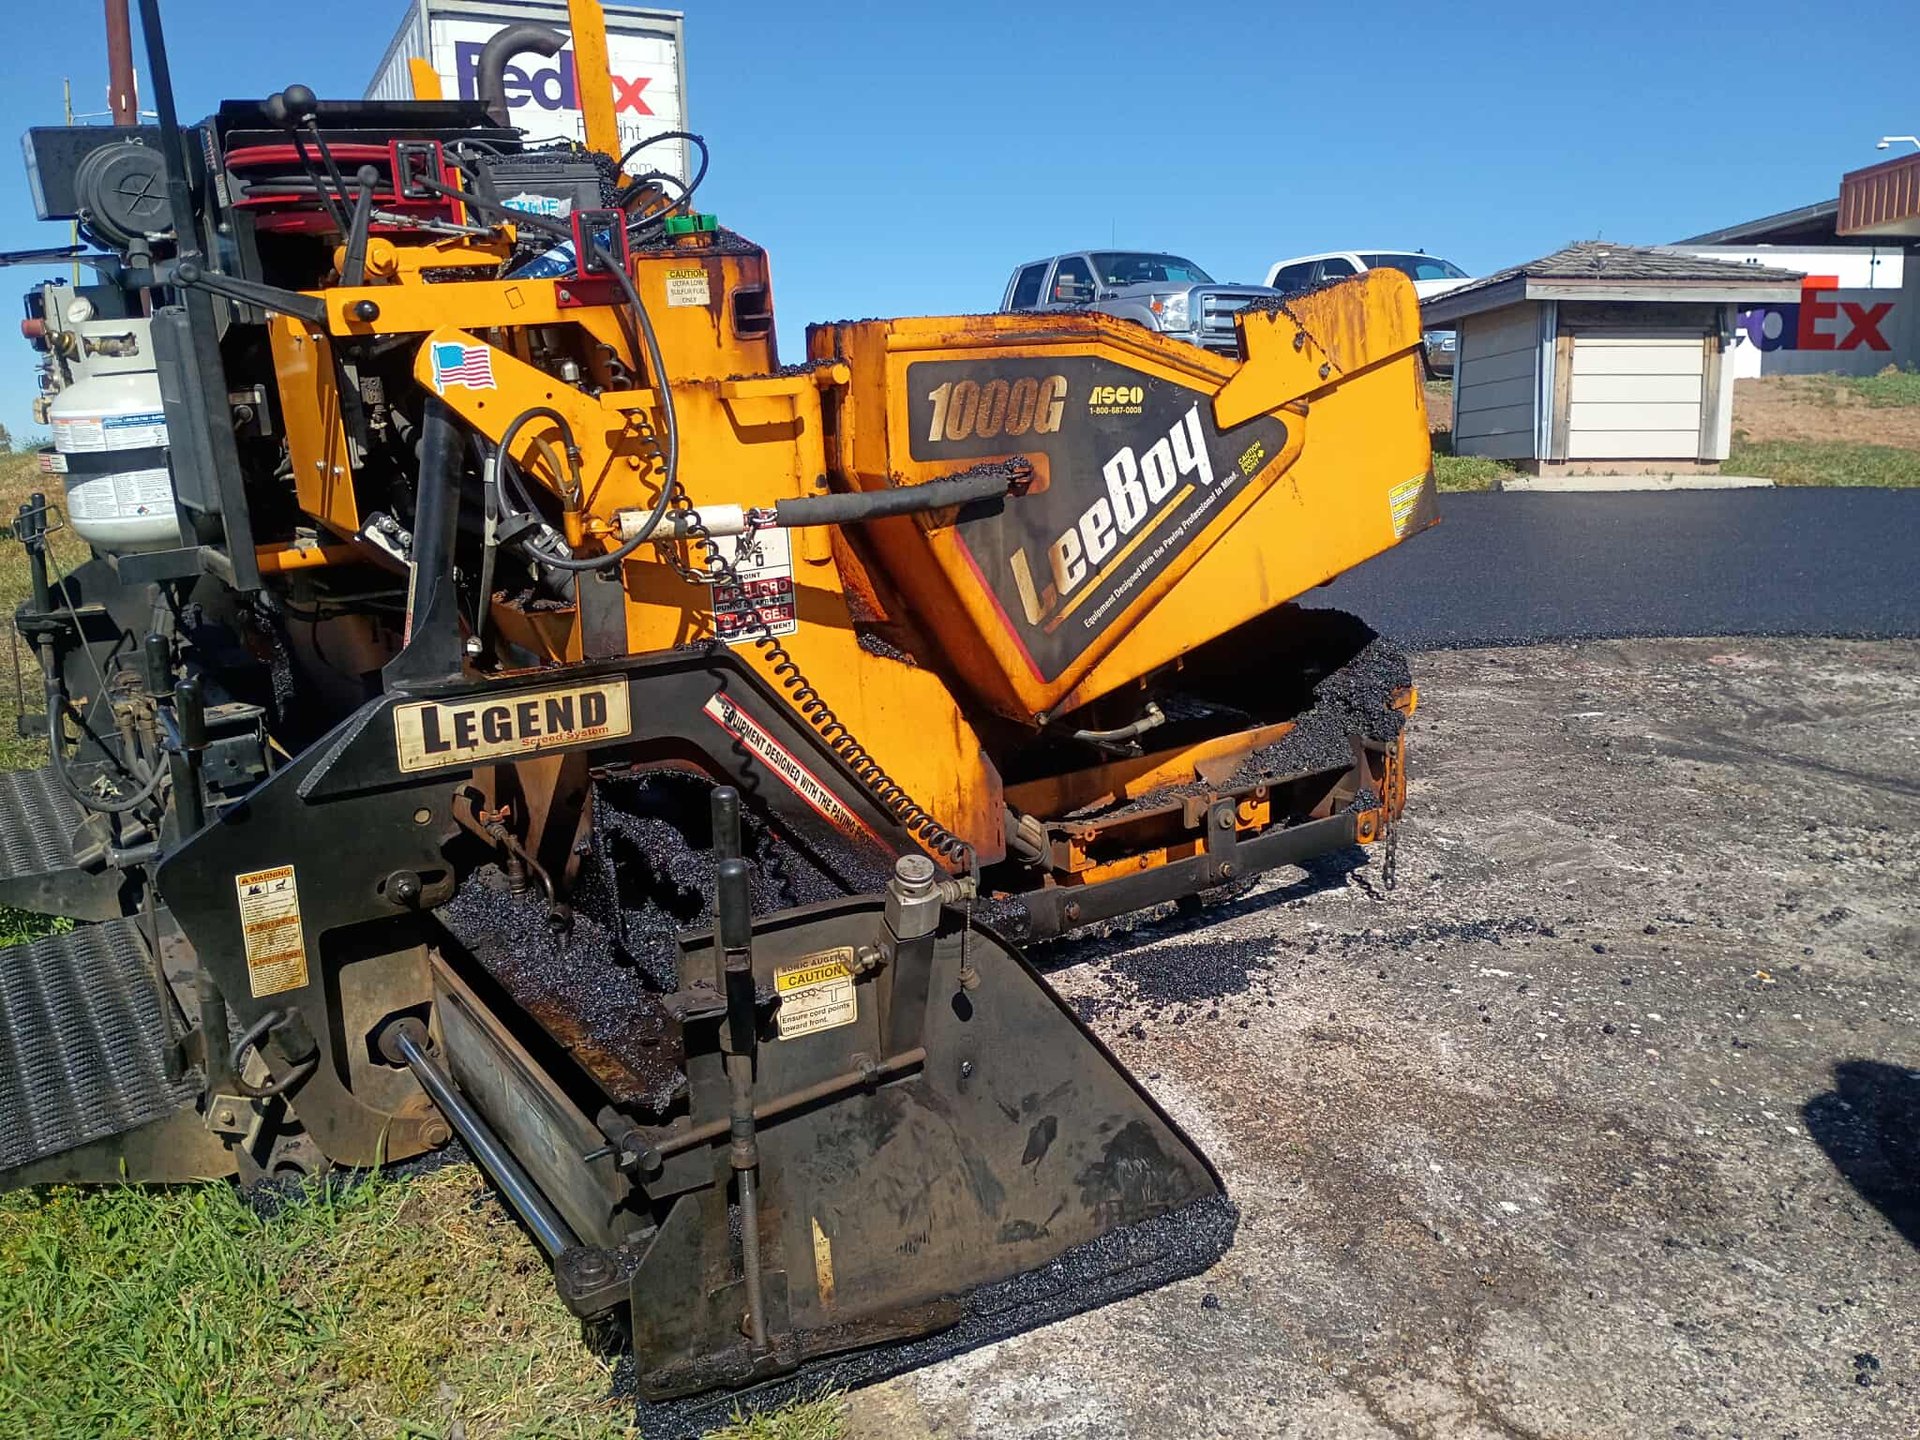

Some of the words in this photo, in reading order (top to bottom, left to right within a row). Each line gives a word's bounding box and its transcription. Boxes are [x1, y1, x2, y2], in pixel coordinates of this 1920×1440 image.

[455, 41, 654, 115] Fedx
[670, 269, 705, 278] CAUTION
[1089, 386, 1144, 404] ASCO
[928, 375, 1067, 442] 1000G
[1238, 440, 1261, 464] CAUTION
[1009, 404, 1214, 626] LeeBoy
[1084, 594, 1116, 628] Equipment
[1113, 567, 1142, 598] Designed
[1139, 555, 1155, 572] With
[1153, 546, 1165, 559] the
[1162, 526, 1184, 549] Paving
[1182, 492, 1217, 530] Professional
[1214, 486, 1224, 497] In
[736, 607, 789, 627] AGER
[420, 691, 608, 755] LEGEND
[522, 732, 563, 746] Screed
[566, 726, 609, 740] System
[764, 741, 801, 785] DESIGNED
[799, 775, 820, 801] WITH
[818, 790, 833, 812] THE
[830, 805, 857, 833] PAVING
[250, 868, 290, 882] WARNING
[789, 966, 842, 986] CAUTION
[782, 1013, 809, 1024] Ensure
[809, 1007, 826, 1017] cord
[828, 1003, 850, 1014] points
[782, 1020, 808, 1033] toward
